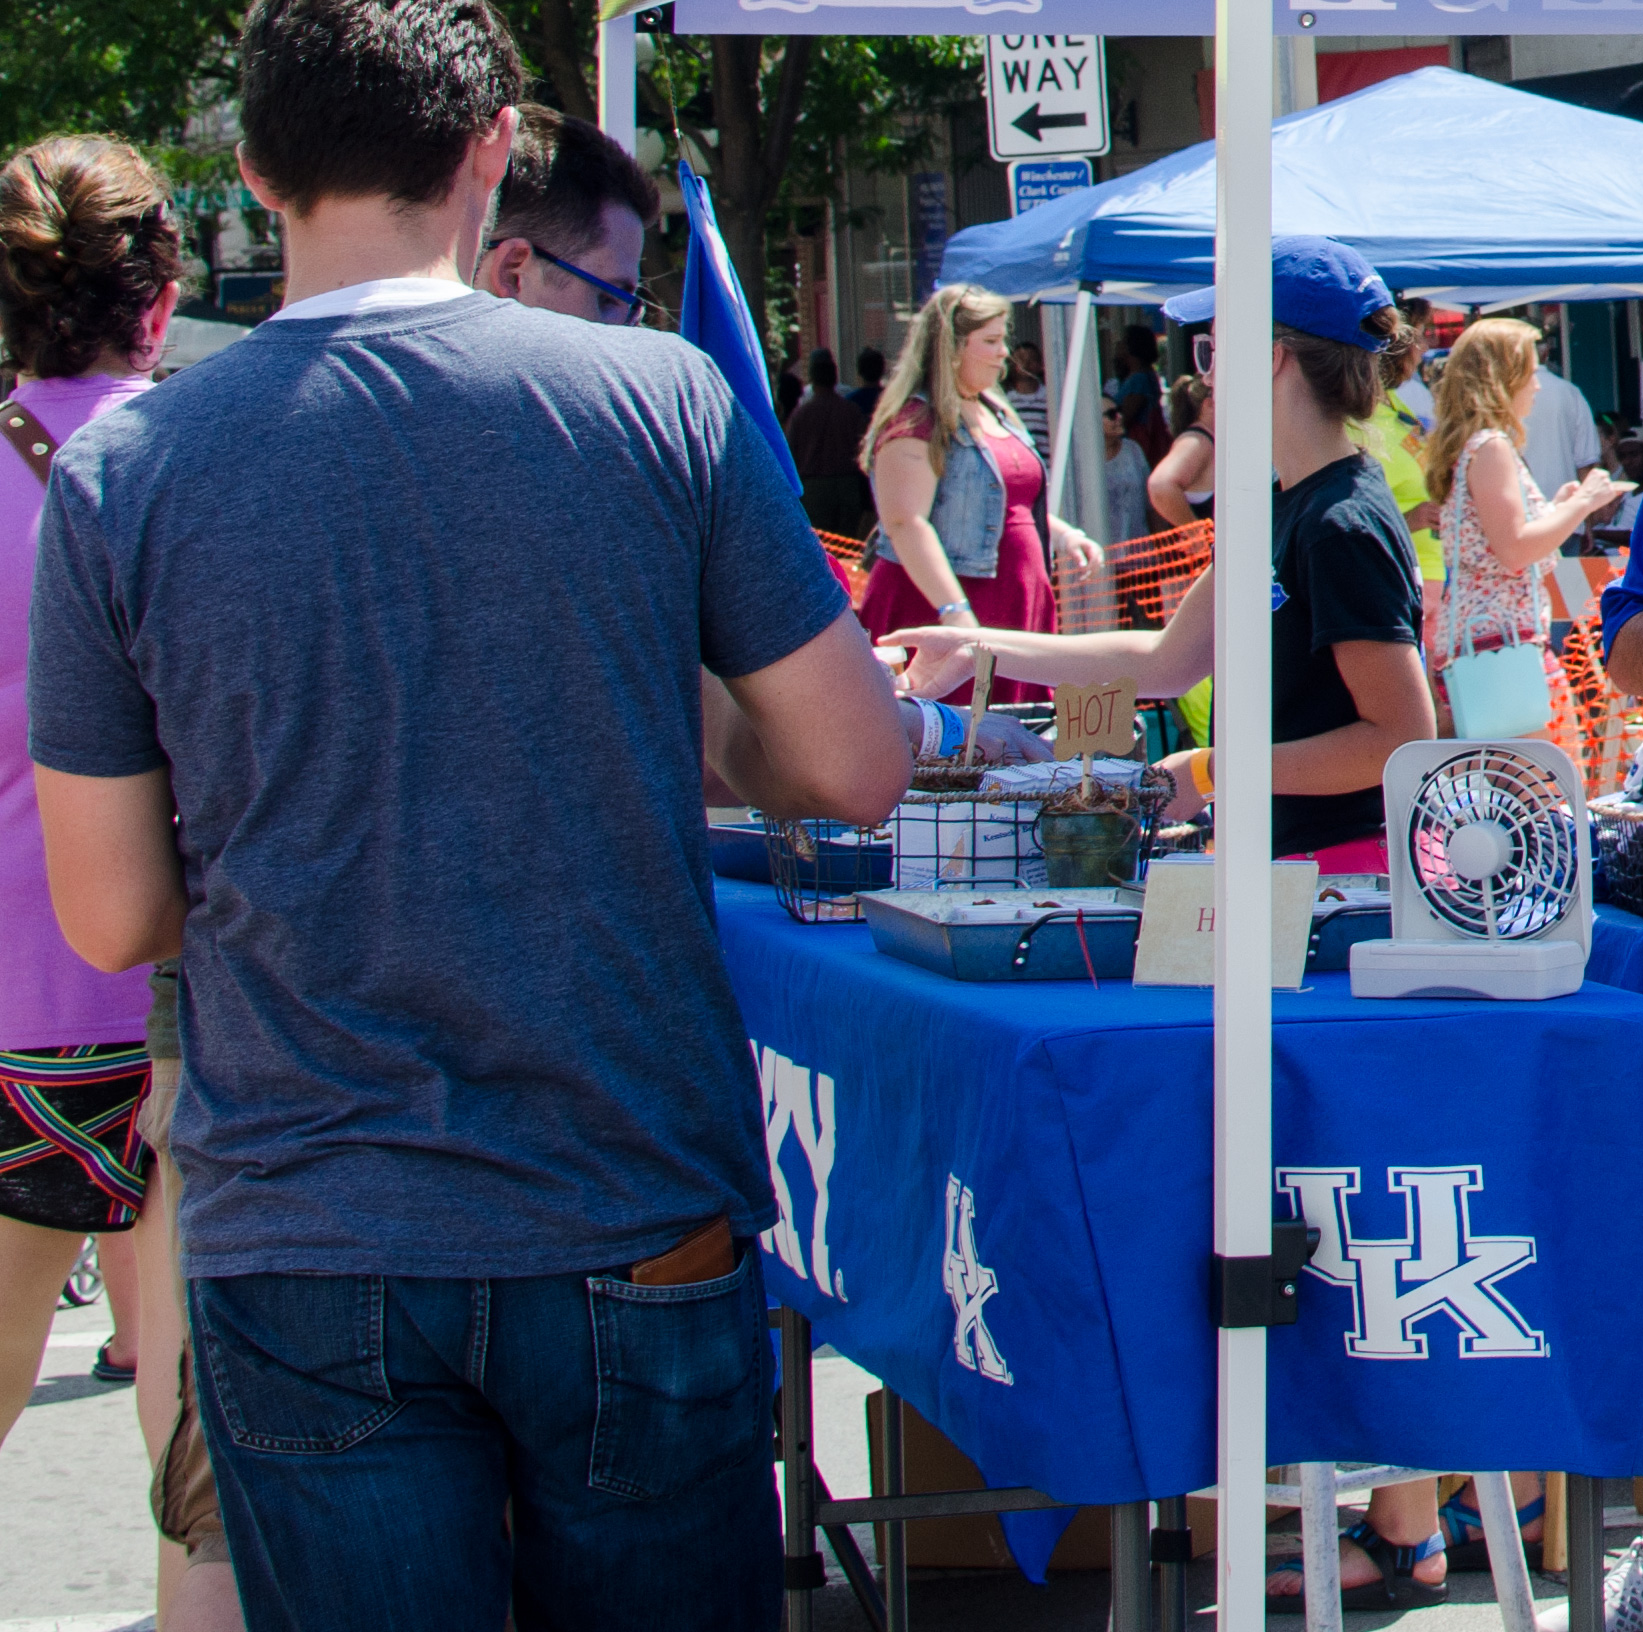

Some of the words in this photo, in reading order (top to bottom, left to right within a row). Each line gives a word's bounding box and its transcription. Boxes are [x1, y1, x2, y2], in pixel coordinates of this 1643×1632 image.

[1002, 56, 1088, 94] WAY
[1066, 689, 1122, 741] HOT
[1274, 1164, 1546, 1361] UK
